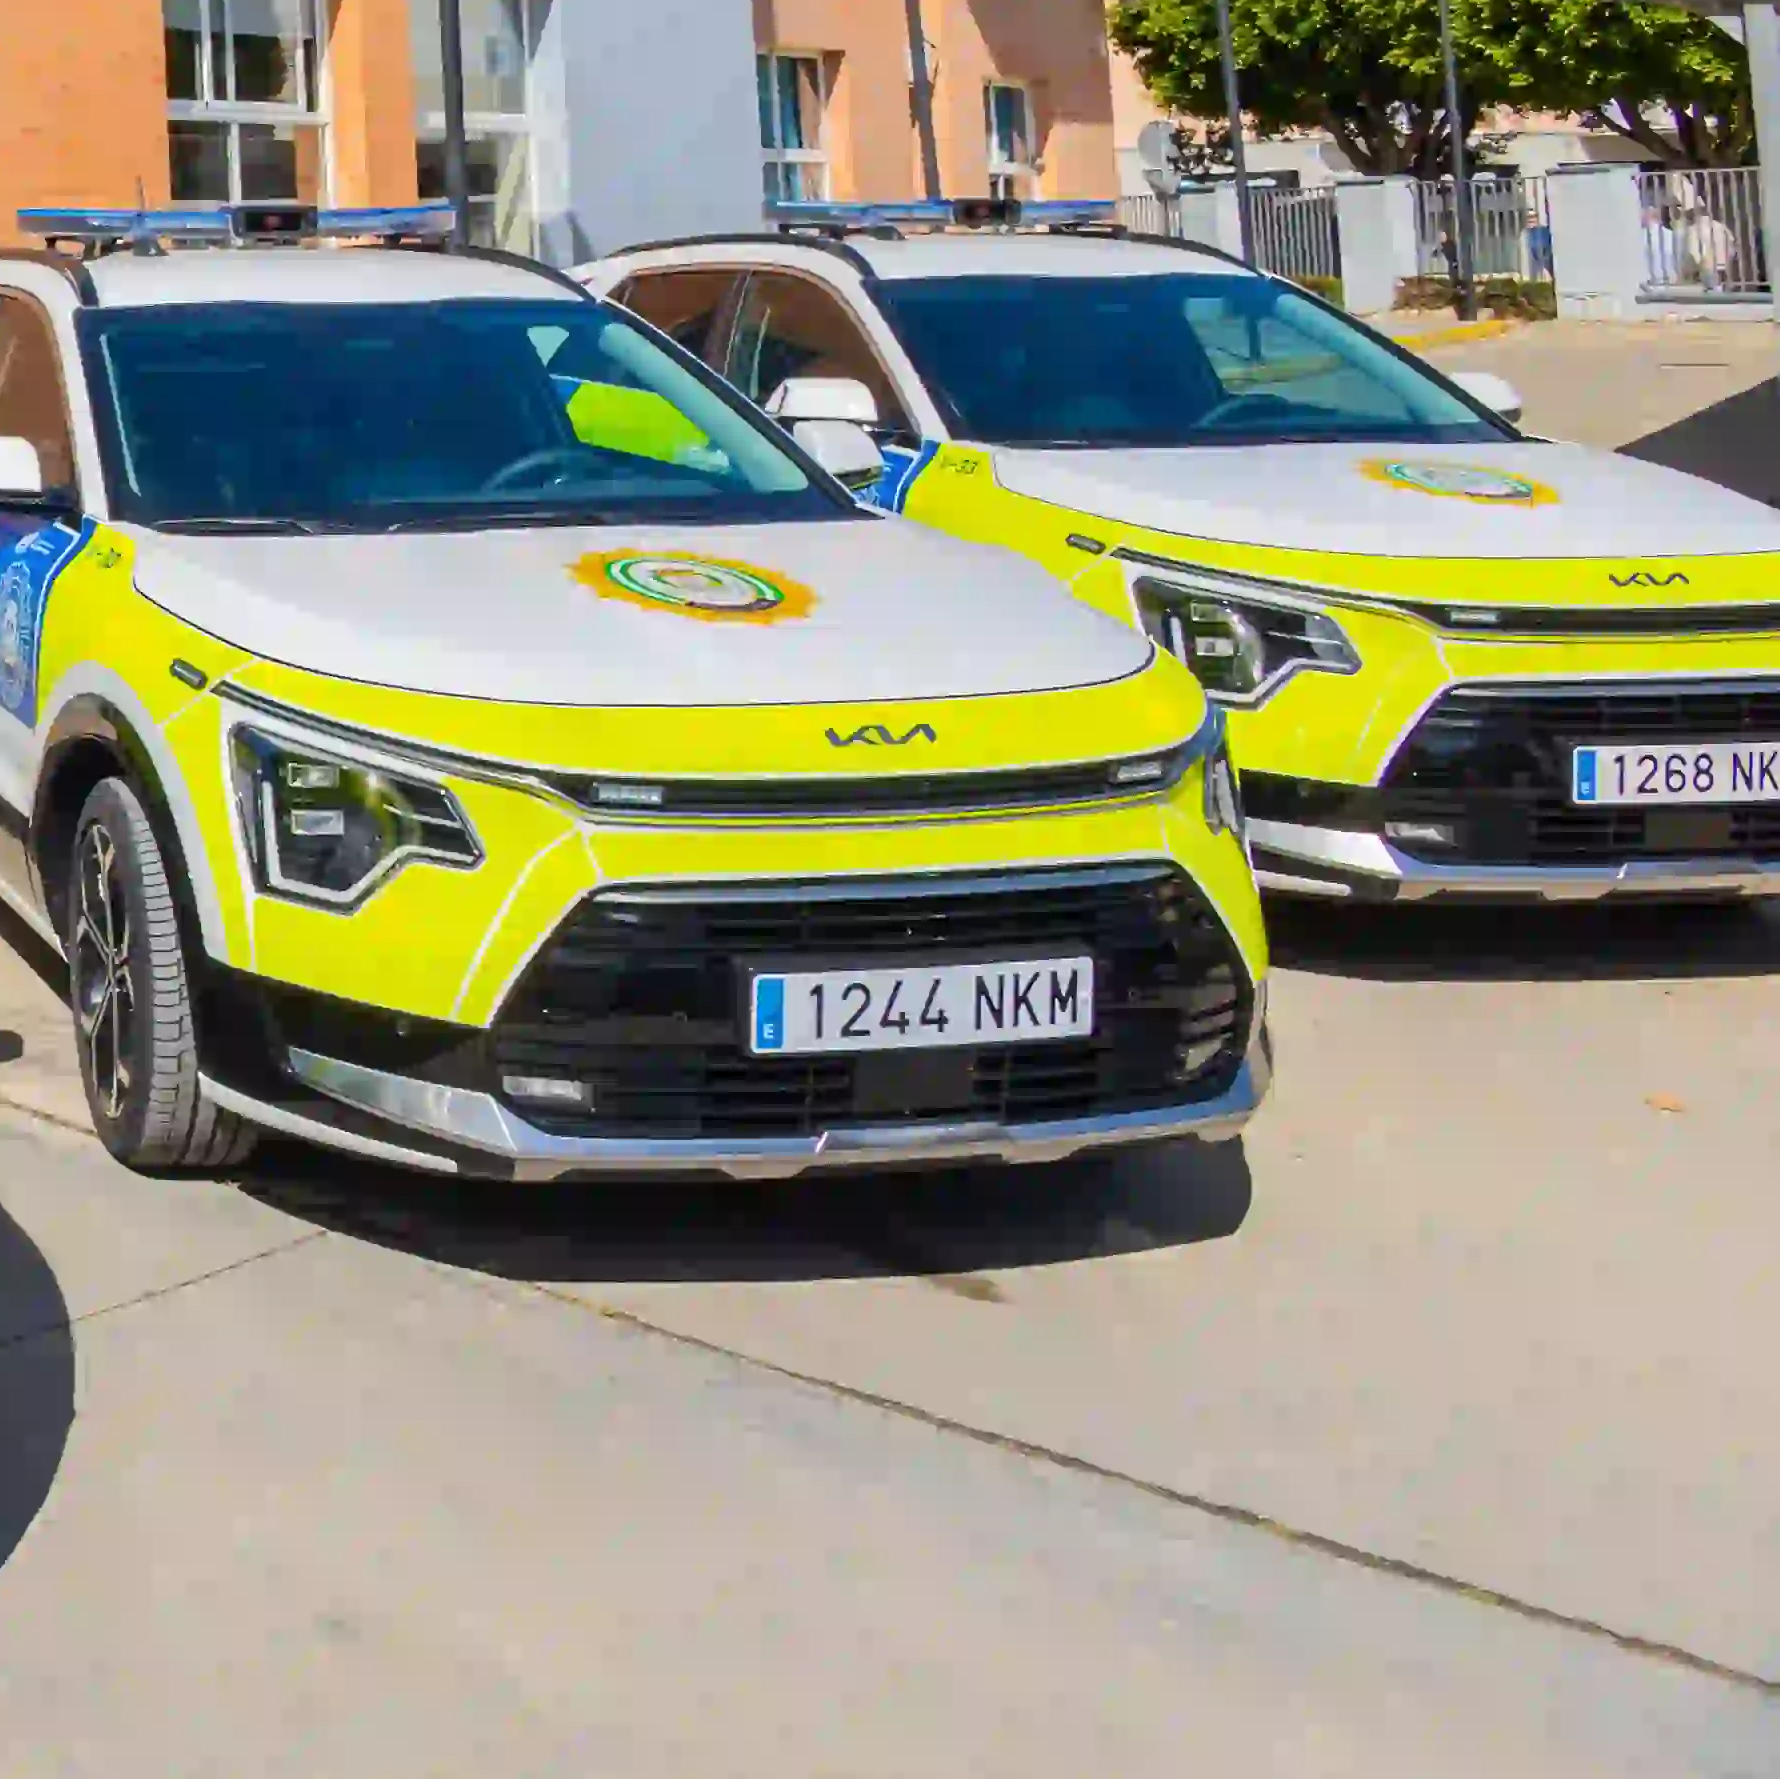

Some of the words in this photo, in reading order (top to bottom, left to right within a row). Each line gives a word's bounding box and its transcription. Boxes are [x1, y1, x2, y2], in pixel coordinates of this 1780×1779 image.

[1607, 571, 1690, 588] KIA
[824, 722, 937, 748] KIA
[1613, 752, 1715, 797] 1268
[809, 978, 949, 1040] 1244
[973, 968, 1079, 1031] NKM
[762, 1023, 775, 1040] E
